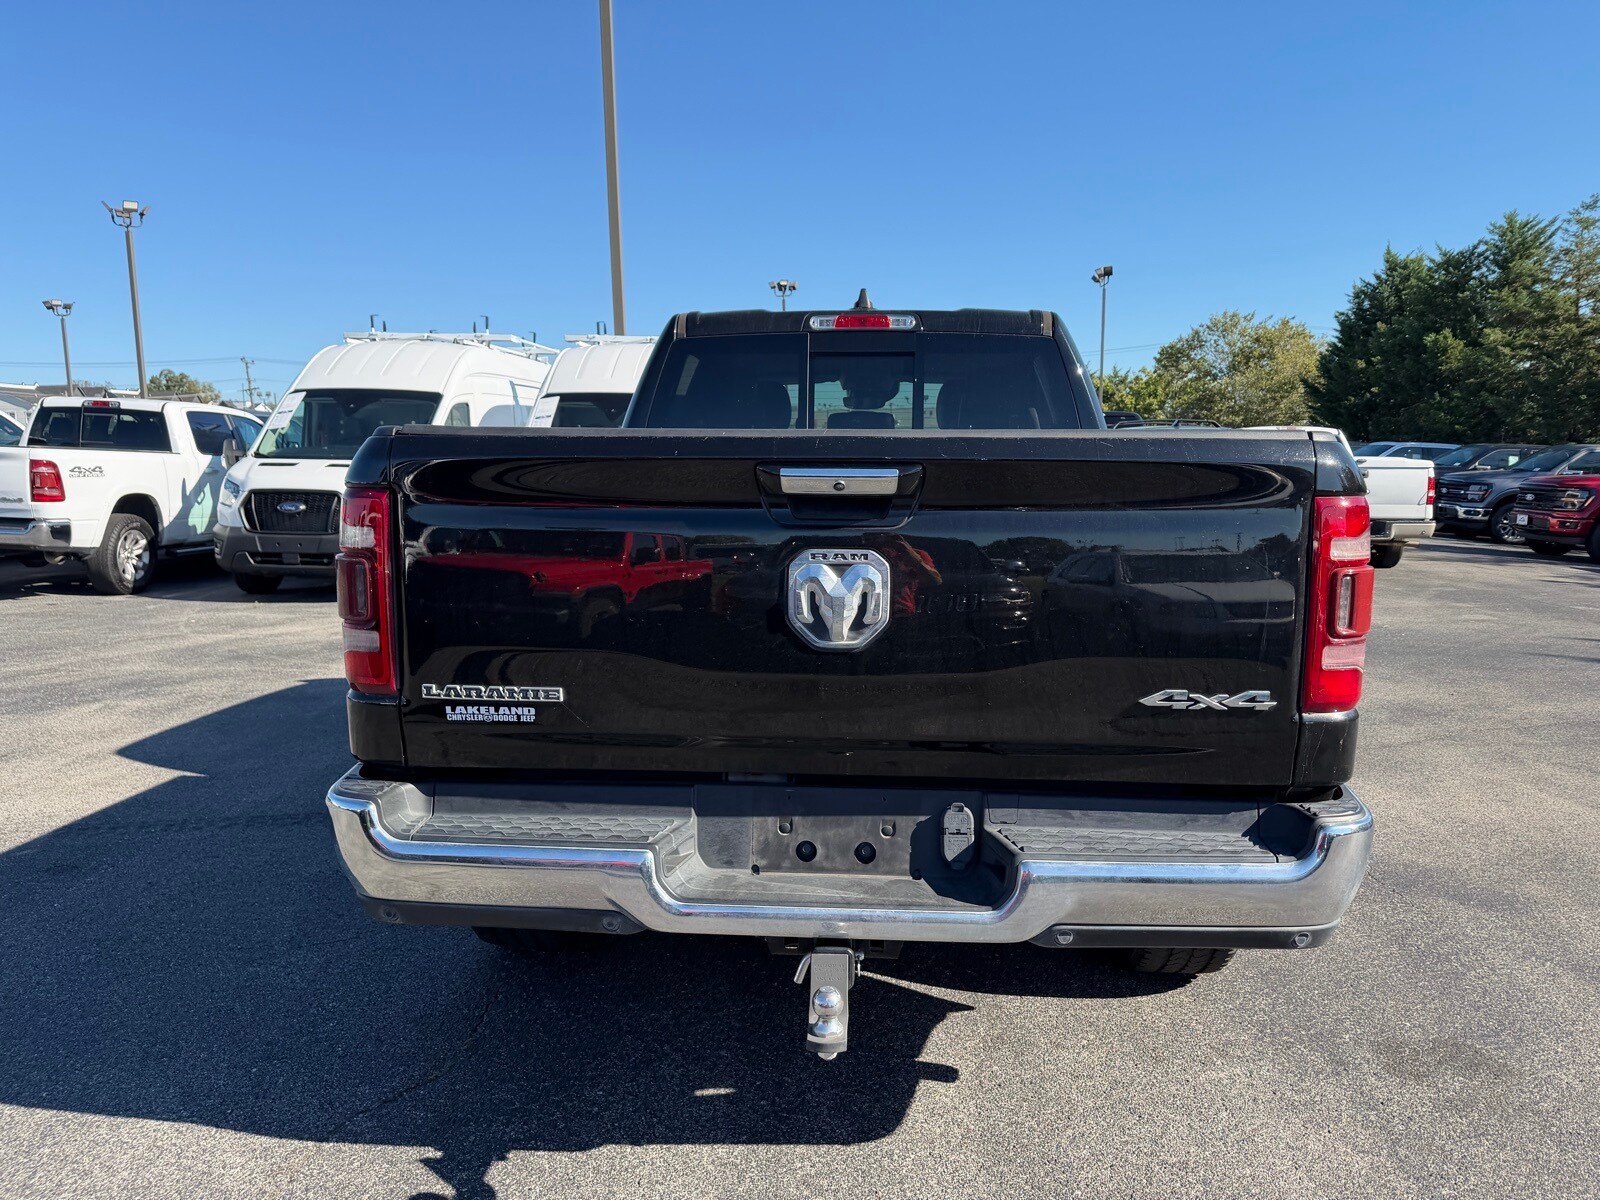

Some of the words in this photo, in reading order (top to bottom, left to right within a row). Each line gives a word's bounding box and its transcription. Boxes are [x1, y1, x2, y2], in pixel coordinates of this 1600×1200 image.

[809, 552, 869, 561] RAM
[422, 684, 564, 702] LARAMIE
[445, 706, 536, 715] LAKELAND
[493, 714, 518, 722] DODGE
